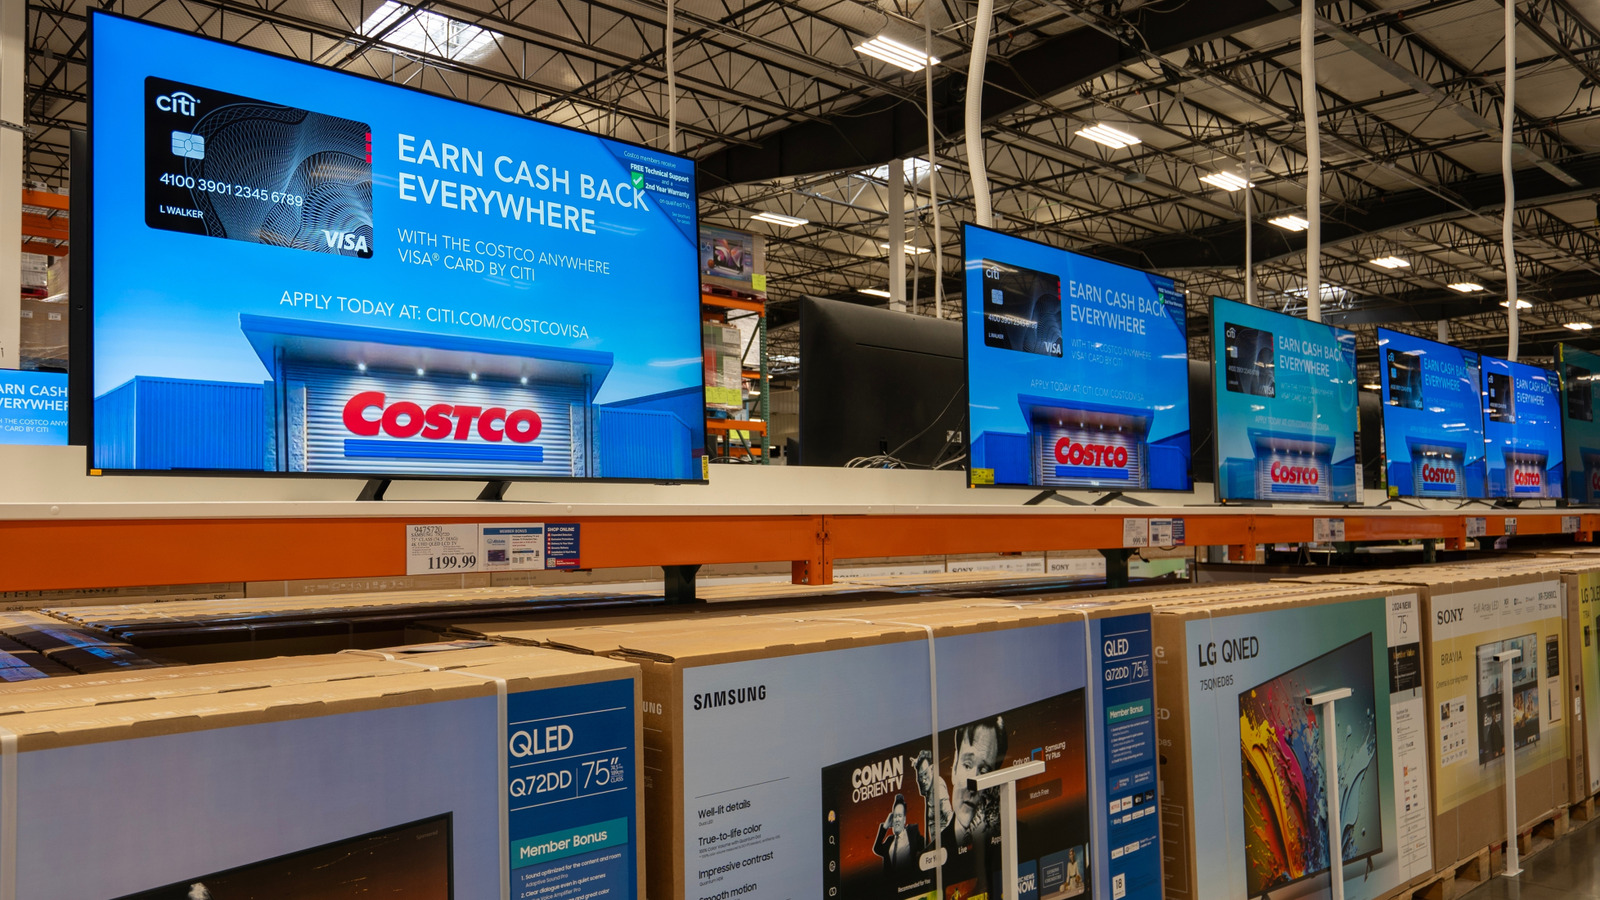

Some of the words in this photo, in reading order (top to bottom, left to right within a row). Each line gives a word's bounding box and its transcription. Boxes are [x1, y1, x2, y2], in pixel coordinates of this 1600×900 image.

[624, 151, 639, 159] Costco
[640, 155, 660, 164] members
[399, 133, 483, 177] EARN
[494, 156, 570, 194] CASH
[581, 174, 649, 212] BACK
[630, 163, 644, 172] FREE
[645, 167, 668, 177] Technical
[669, 173, 689, 183] Support
[160, 173, 194, 189] 4100
[198, 179, 231, 195] 3901
[235, 185, 268, 202] 2345
[271, 191, 302, 207] 6789
[667, 188, 689, 199] Warranty
[399, 172, 596, 234] EVERYWHERE
[165, 206, 203, 219] WALKER
[322, 230, 368, 252] VISA
[398, 228, 437, 247] WITH
[442, 235, 470, 252] THE
[475, 241, 535, 263] COSTCO
[538, 253, 610, 275] ANYWHERE
[444, 256, 484, 273] CARD
[490, 262, 506, 277] BY
[511, 265, 535, 281] CITI
[1070, 280, 1101, 304] EARN
[1105, 289, 1135, 311] CASH
[1139, 296, 1166, 318] BACK
[280, 291, 332, 310] APPLY
[336, 297, 394, 317] TODAY
[399, 304, 421, 320] AT:
[426, 308, 588, 339] CITI.COM/COSTCOVISA
[1071, 304, 1145, 335] EVERYWHERE
[1044, 342, 1061, 354] VISA
[1279, 336, 1300, 353] EARN
[1302, 341, 1322, 358] CASH
[1325, 347, 1343, 362] BACK
[1280, 355, 1329, 377] EVERYWHERE
[1424, 358, 1439, 372] EARN
[1441, 361, 1455, 375] CASH
[30, 385, 67, 397] CASH
[1031, 379, 1049, 390] APPLY
[1051, 381, 1071, 392] TODAY
[1425, 374, 1460, 391] EVERYWHERE
[1516, 379, 1528, 390] EARN
[1530, 380, 1540, 392] CASH
[1541, 382, 1552, 394] BACK
[1517, 392, 1544, 406] EVERYWHERE
[429, 555, 476, 569] 1199.99
[1402, 601, 1411, 609] NEW
[1581, 588, 1588, 604] LG
[1437, 607, 1464, 625] SONY
[1104, 638, 1128, 658] QLED
[1198, 642, 1216, 667] LG
[1222, 636, 1259, 663] QNED
[1441, 651, 1462, 665] BRAVIA
[1105, 666, 1129, 681] Q72DD
[1200, 674, 1233, 691] 75QNED85
[693, 684, 766, 711] SAMSUNG
[1110, 708, 1128, 719] Member
[1130, 705, 1143, 715] Bonus
[510, 724, 574, 758] QLED
[1045, 741, 1066, 753] Samsung
[852, 755, 903, 788] CONAN
[510, 770, 572, 798] Q72DD
[698, 805, 724, 818] Well-lit
[726, 800, 751, 812] details
[698, 827, 741, 846] True-to-life
[743, 824, 762, 834] color
[520, 836, 570, 860] Member
[573, 830, 608, 847] Bonus
[958, 847, 968, 855] Live
[541, 866, 564, 877] optimized
[581, 858, 599, 867] content
[699, 861, 740, 880] Impressive
[742, 851, 774, 867] contrast
[525, 879, 546, 888] Adaptive
[540, 884, 560, 894] dialogue
[730, 883, 757, 897] motion
